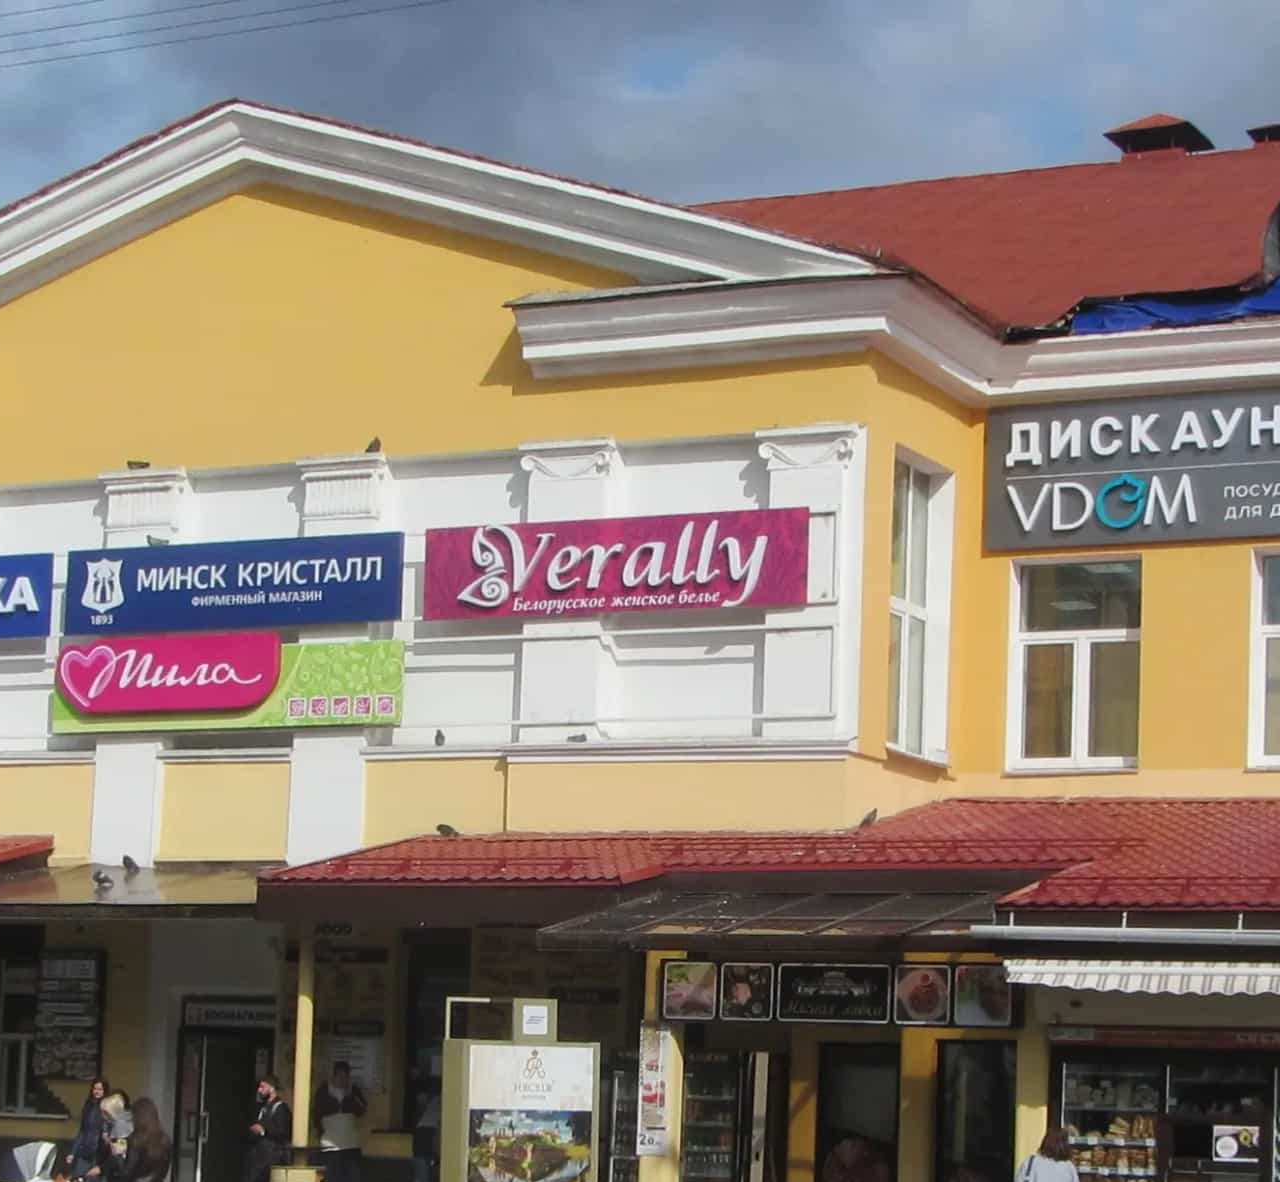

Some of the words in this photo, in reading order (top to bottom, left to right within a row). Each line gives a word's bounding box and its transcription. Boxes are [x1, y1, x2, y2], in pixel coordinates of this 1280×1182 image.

[1006, 472, 1198, 533] VDOM
[1223, 504, 1263, 522] ДЛЯ
[136, 563, 227, 593] МИНСК
[237, 556, 383, 589] КРИСТАЛЛ
[457, 519, 769, 608] Verally
[191, 590, 266, 608] ФИРМЕННЫЙ
[268, 588, 323, 605] МАГАЗИН
[512, 594, 607, 616] Белорусское
[609, 592, 675, 608] женское
[677, 589, 721, 605] белье
[90, 614, 114, 626] 1893
[87, 646, 263, 699] Мила
